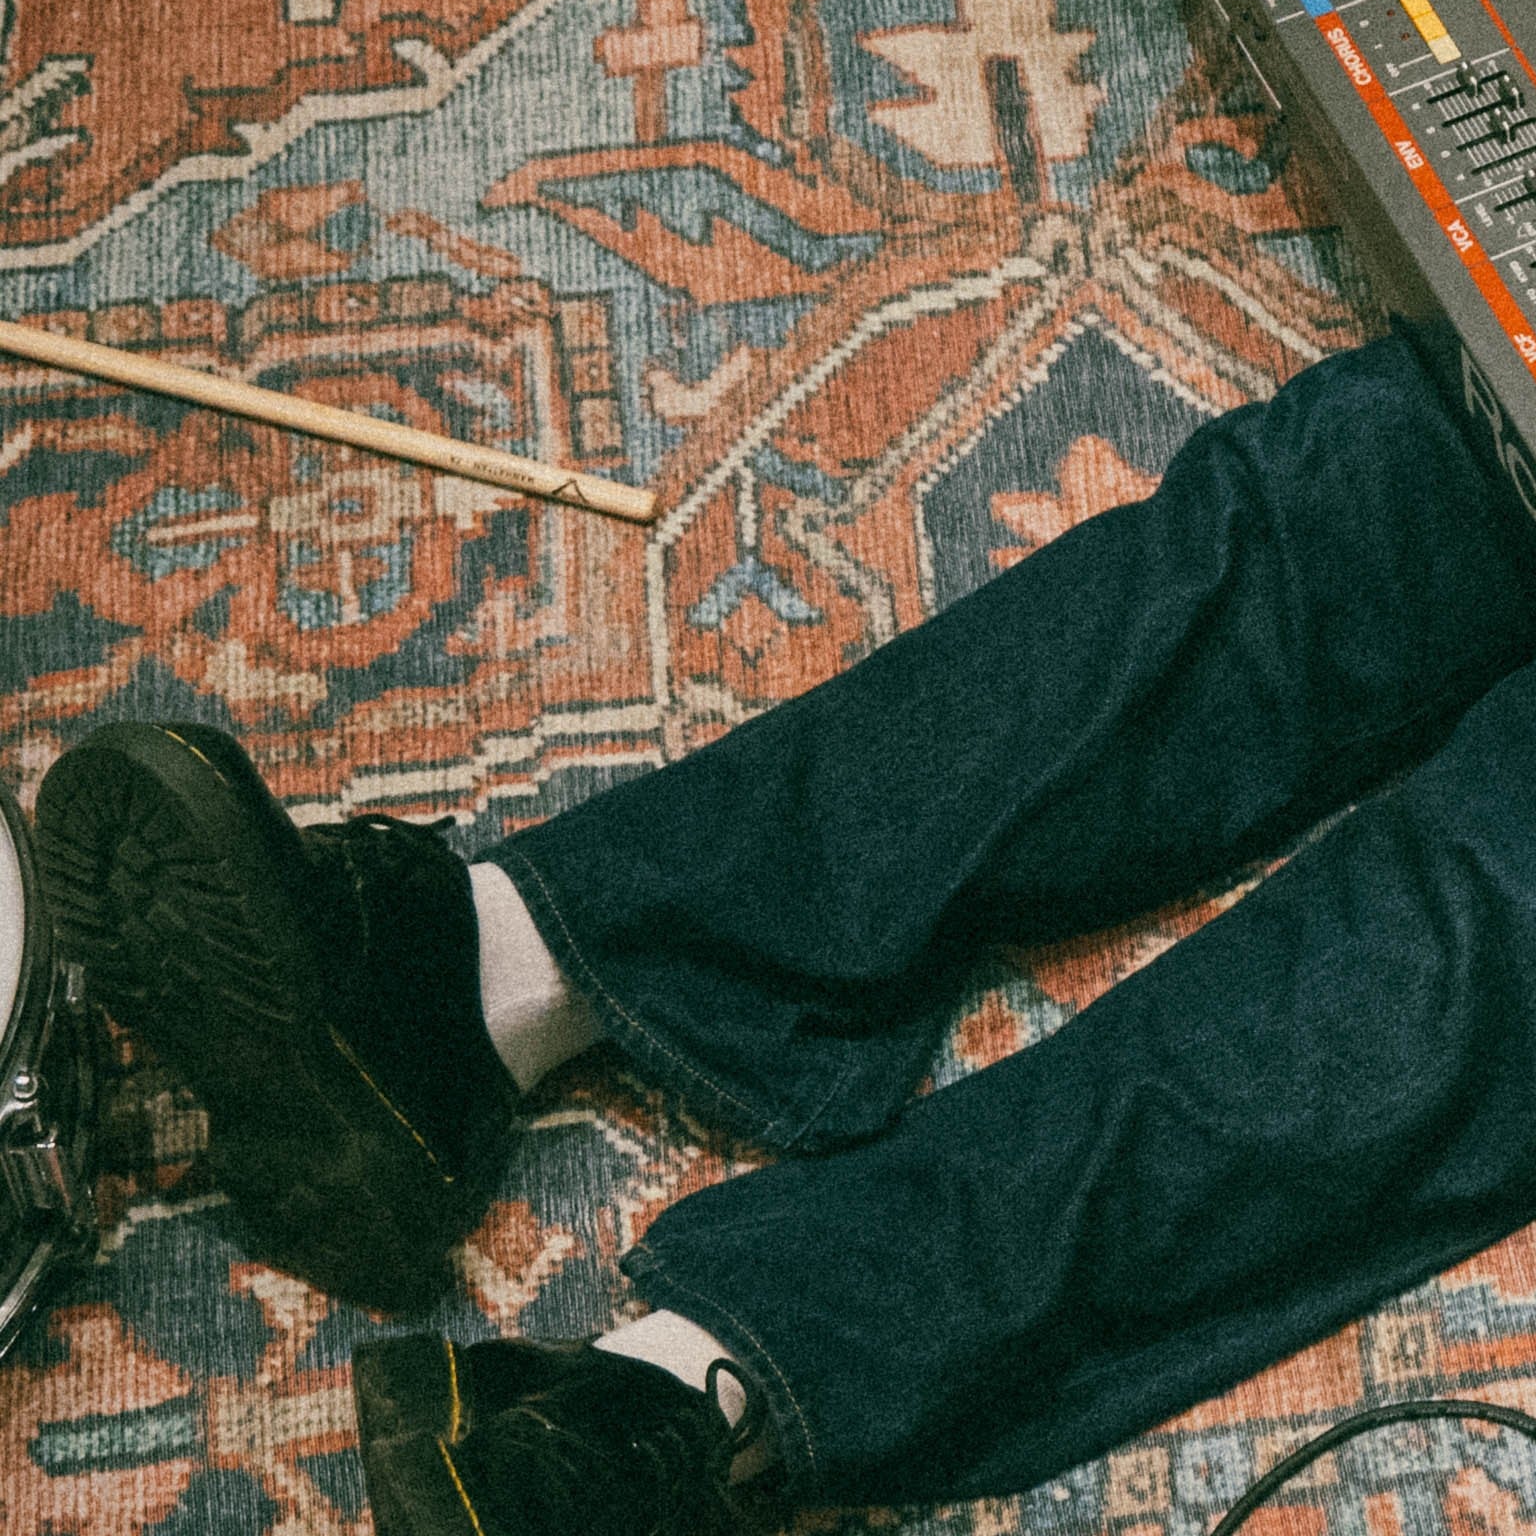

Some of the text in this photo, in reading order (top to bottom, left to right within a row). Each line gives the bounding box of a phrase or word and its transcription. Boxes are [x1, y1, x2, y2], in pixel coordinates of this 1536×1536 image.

[1327, 28, 1372, 85] CHORUS
[1395, 141, 1424, 170] ENV
[1447, 219, 1473, 252] VCA
